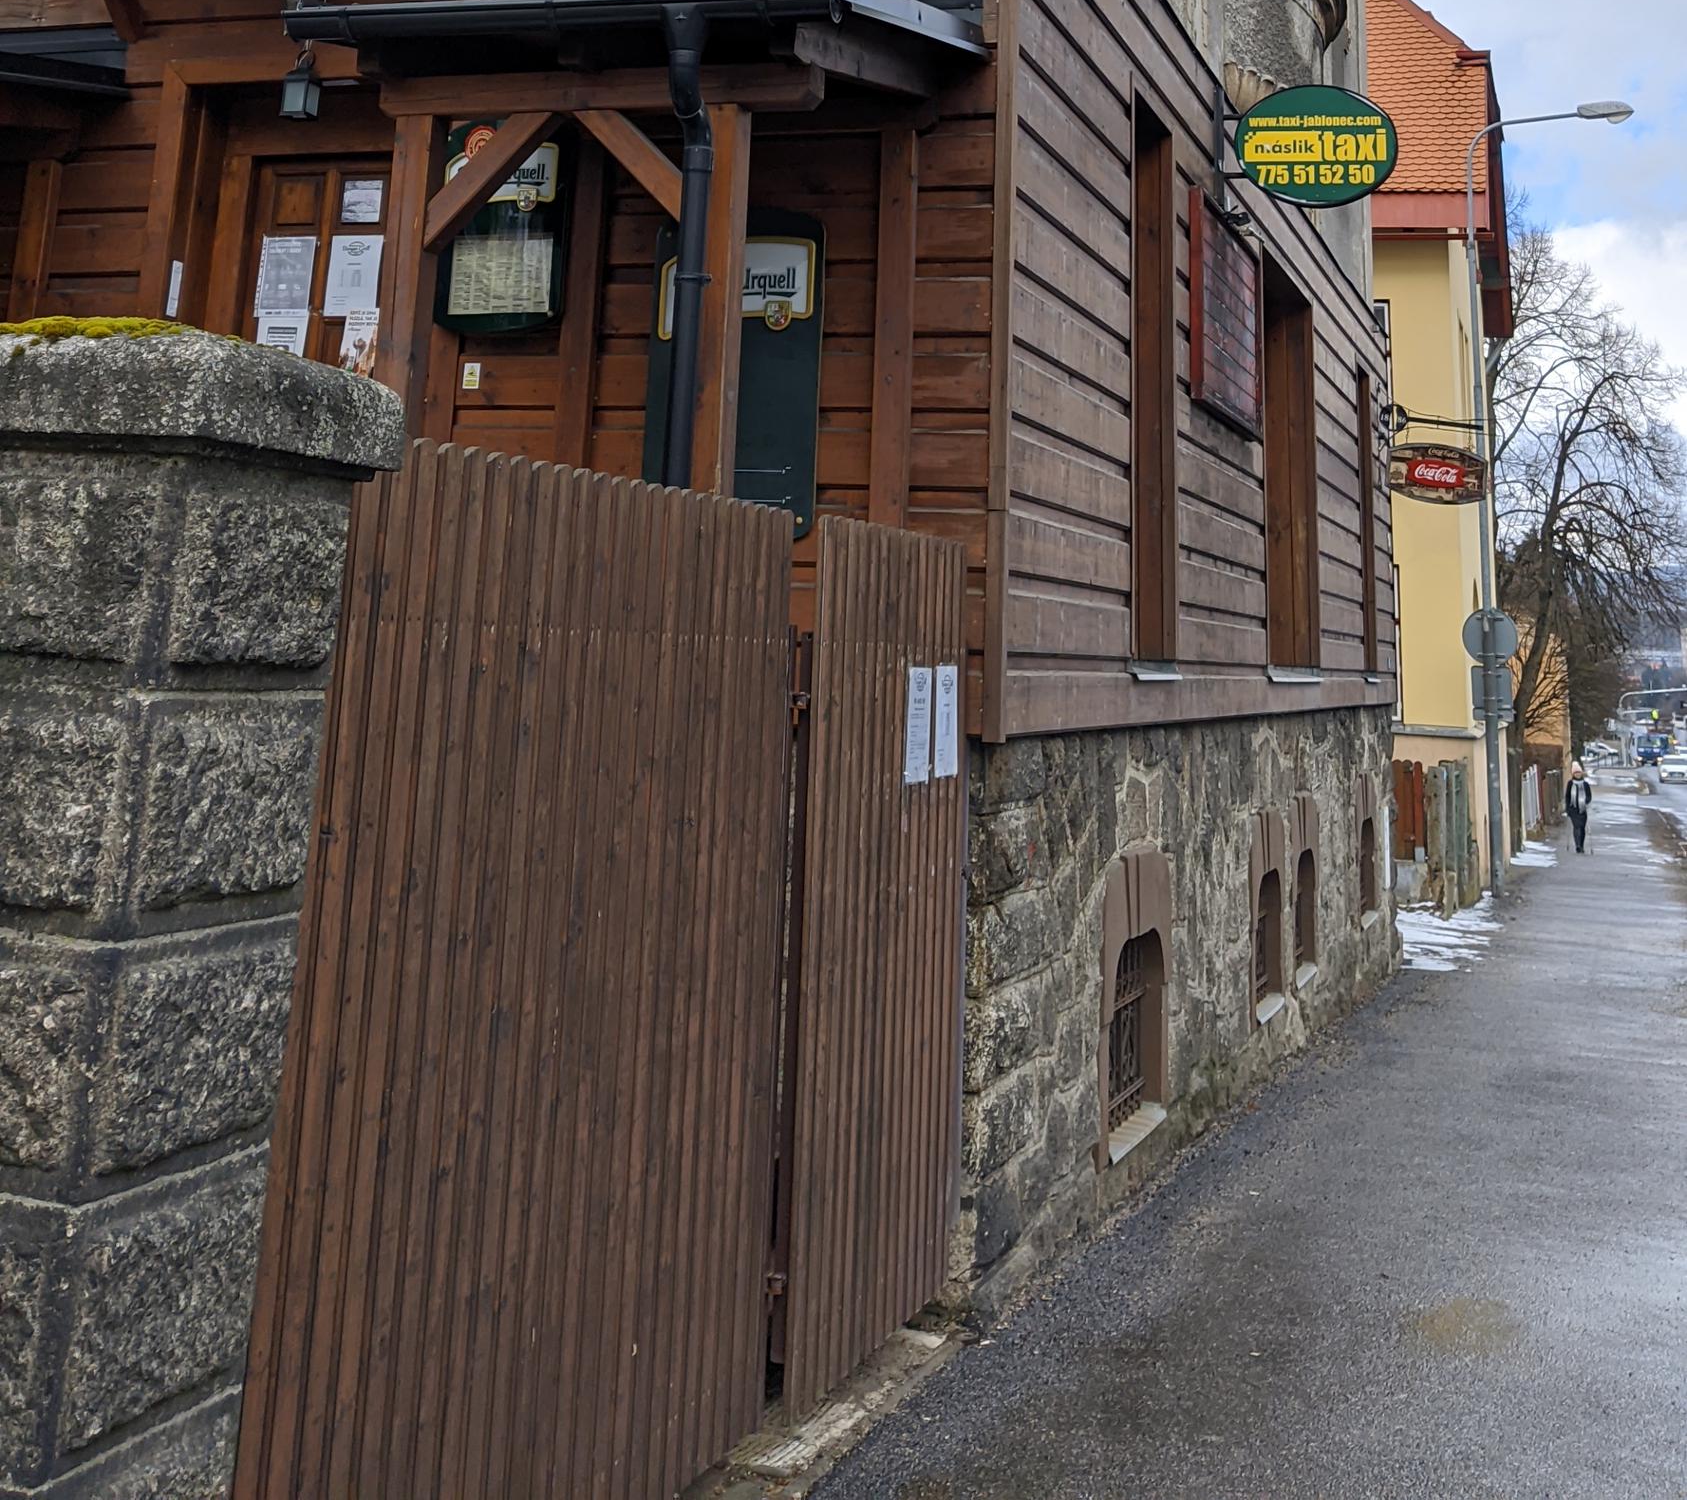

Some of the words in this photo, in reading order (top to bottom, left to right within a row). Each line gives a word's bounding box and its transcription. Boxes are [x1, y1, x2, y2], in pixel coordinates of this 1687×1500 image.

[1248, 115, 1382, 128] www.taxi-jablonec.com
[1321, 128, 1387, 162] taxi
[513, 163, 546, 187] quell
[1256, 164, 1290, 187] 775
[1293, 164, 1315, 185] 51
[1319, 164, 1345, 185] 52
[1348, 163, 1376, 185] 50
